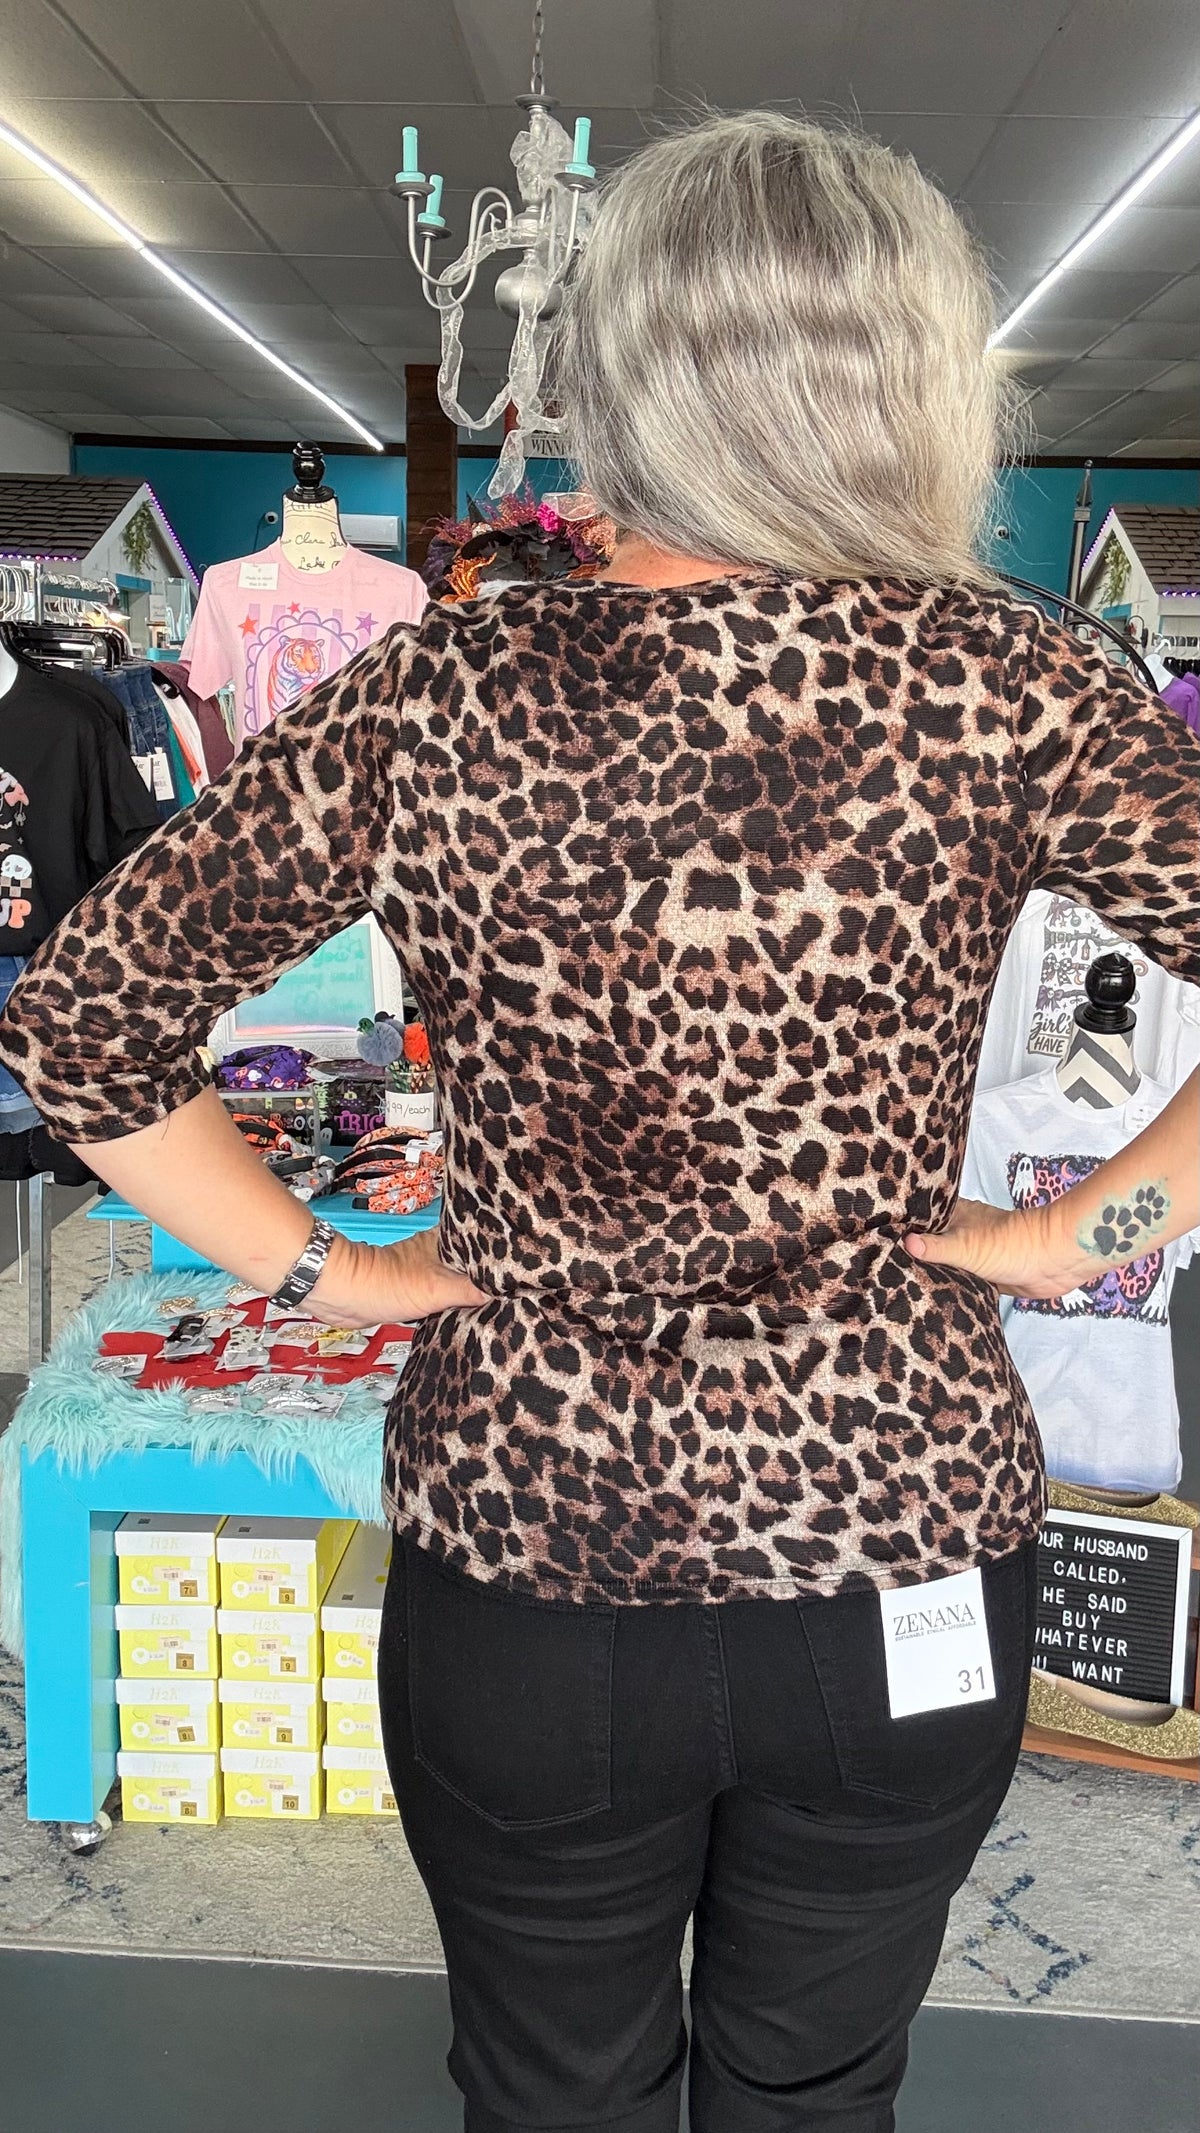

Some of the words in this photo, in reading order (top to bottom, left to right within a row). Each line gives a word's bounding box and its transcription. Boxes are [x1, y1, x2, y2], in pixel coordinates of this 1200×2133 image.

[530, 438, 571, 457] WINN
[1033, 1036, 1066, 1054] HAVE
[1074, 1535, 1148, 1561] HUSBAND
[1043, 1586, 1065, 1605] HE
[1087, 1593, 1127, 1614] SAID
[893, 1603, 976, 1637] ZENANA
[1062, 1610, 1100, 1631] BUY
[957, 1665, 986, 1694] 31
[1072, 1660, 1124, 1685] WANT
